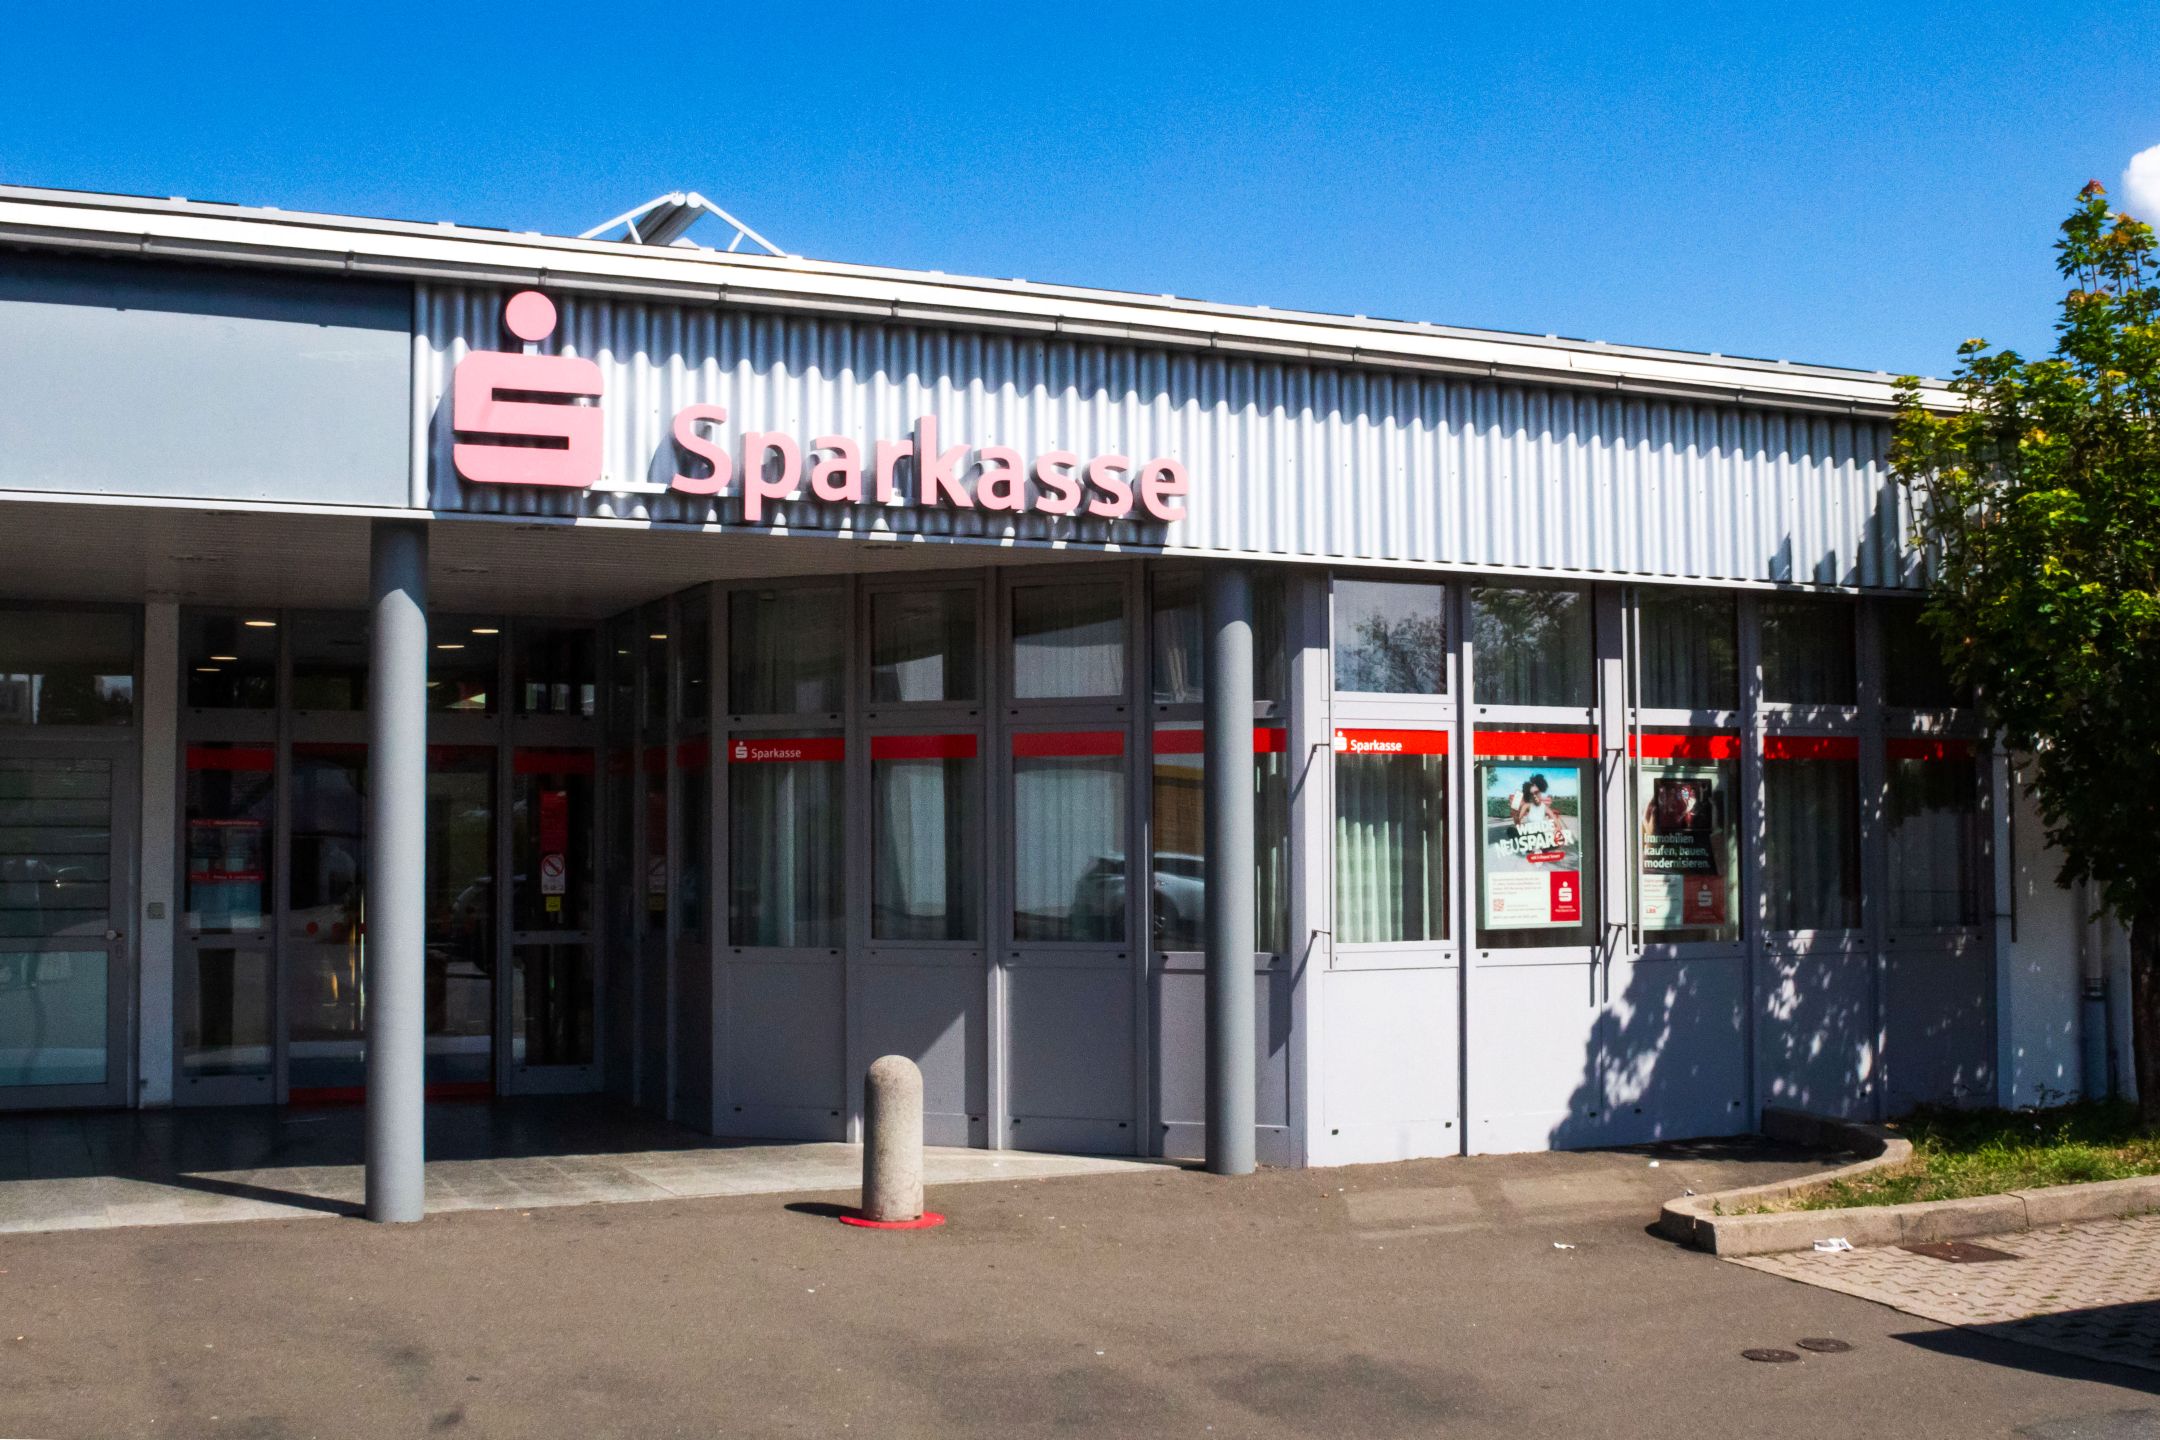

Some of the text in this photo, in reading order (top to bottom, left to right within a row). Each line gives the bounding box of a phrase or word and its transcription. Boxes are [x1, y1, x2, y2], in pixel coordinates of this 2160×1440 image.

[671, 403, 1190, 523] Sparkasse
[1350, 739, 1402, 753] Sparkasse
[751, 748, 802, 760] Sparkasse
[1644, 832, 1694, 844] Immobilien
[1644, 844, 1678, 857] kaufen,
